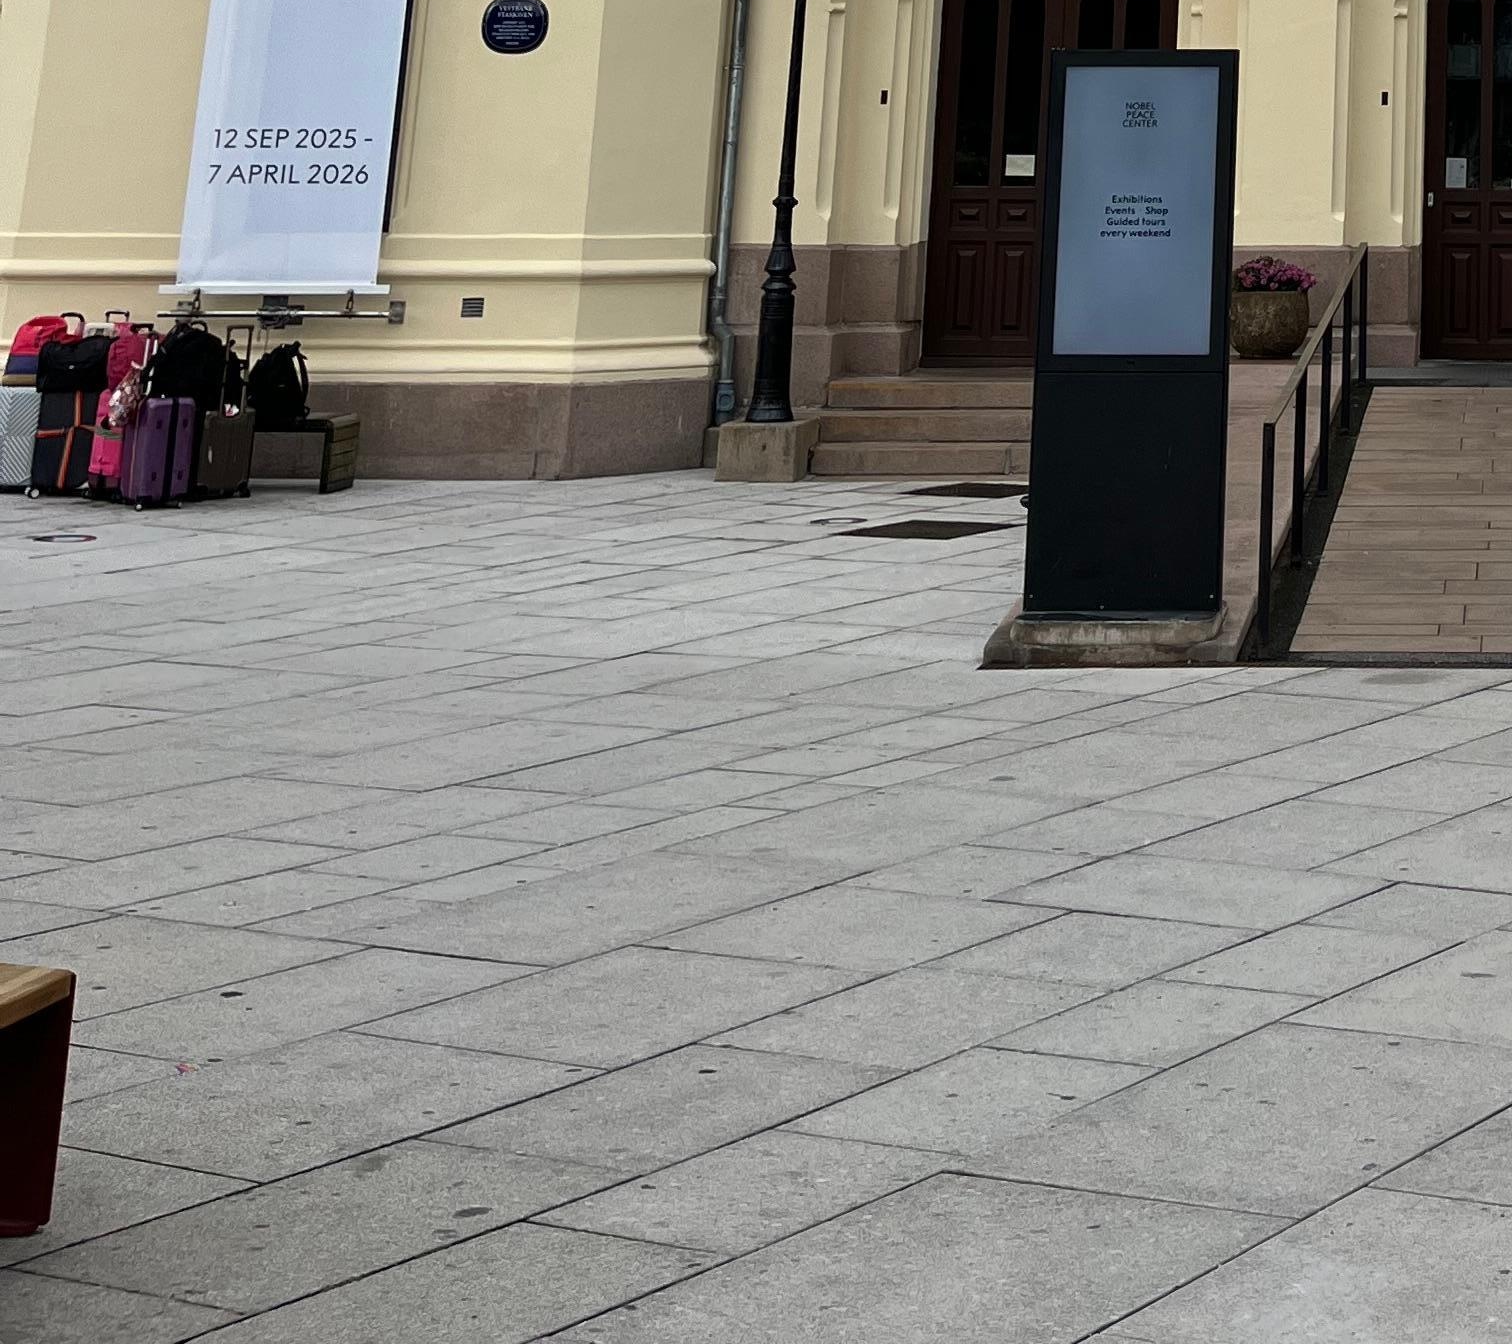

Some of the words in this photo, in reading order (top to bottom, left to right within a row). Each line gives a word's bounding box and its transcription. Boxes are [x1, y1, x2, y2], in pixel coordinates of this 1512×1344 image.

[1125, 102, 1156, 110] NOBEL
[1126, 111, 1154, 119] PEACE
[1122, 120, 1158, 128] CENTER
[215, 129, 237, 148] 12
[245, 129, 289, 148] SEP
[296, 129, 356, 148] 2025
[209, 165, 221, 184] 7
[227, 165, 300, 184] APRIL
[307, 164, 368, 184] 2026
[1112, 195, 1163, 204] Exhibitions
[1104, 206, 1136, 215] Events
[1145, 206, 1169, 217] Shop
[1106, 217, 1140, 226] Guided
[1142, 217, 1166, 226] tours
[1100, 230, 1128, 239] every
[1129, 229, 1171, 238] weekend
